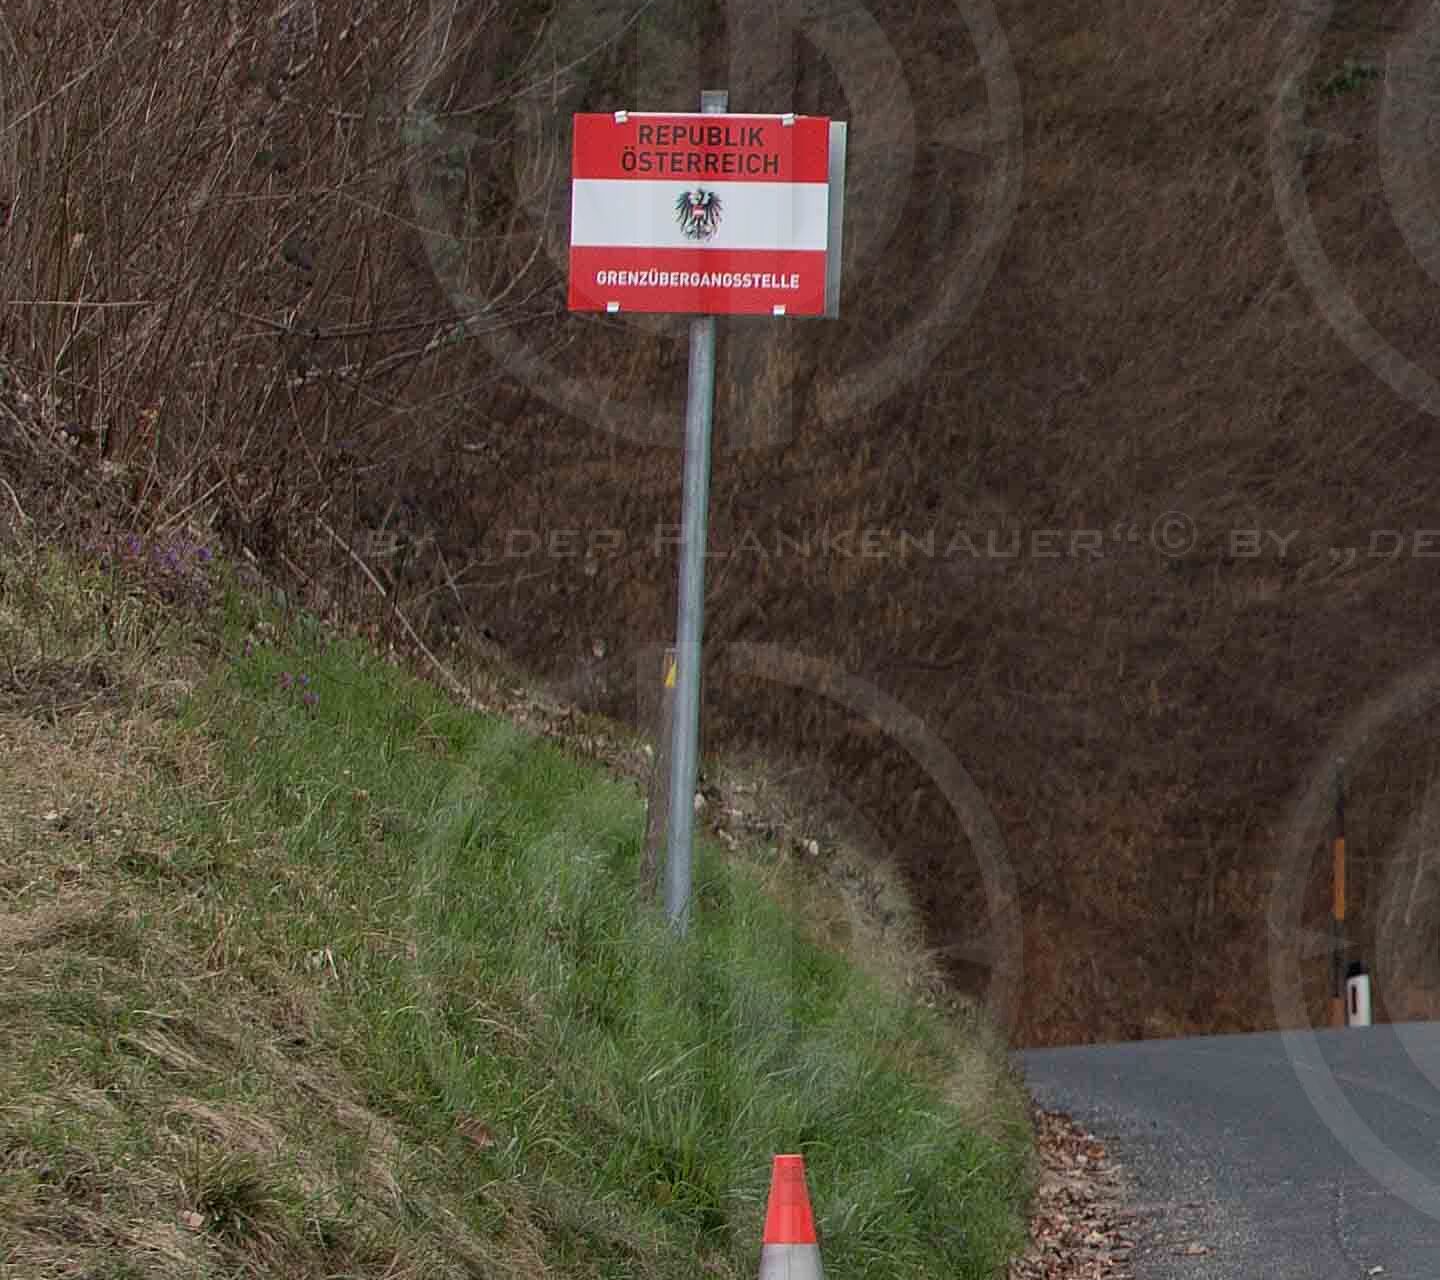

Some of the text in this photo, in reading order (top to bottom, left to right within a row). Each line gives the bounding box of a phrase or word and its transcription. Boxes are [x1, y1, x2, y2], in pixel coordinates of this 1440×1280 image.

[638, 124, 766, 147] REPUBLIK
[621, 145, 780, 175] ÖSTERREICH
[596, 267, 800, 290] GRENZÜBERGANGSSTELLE
